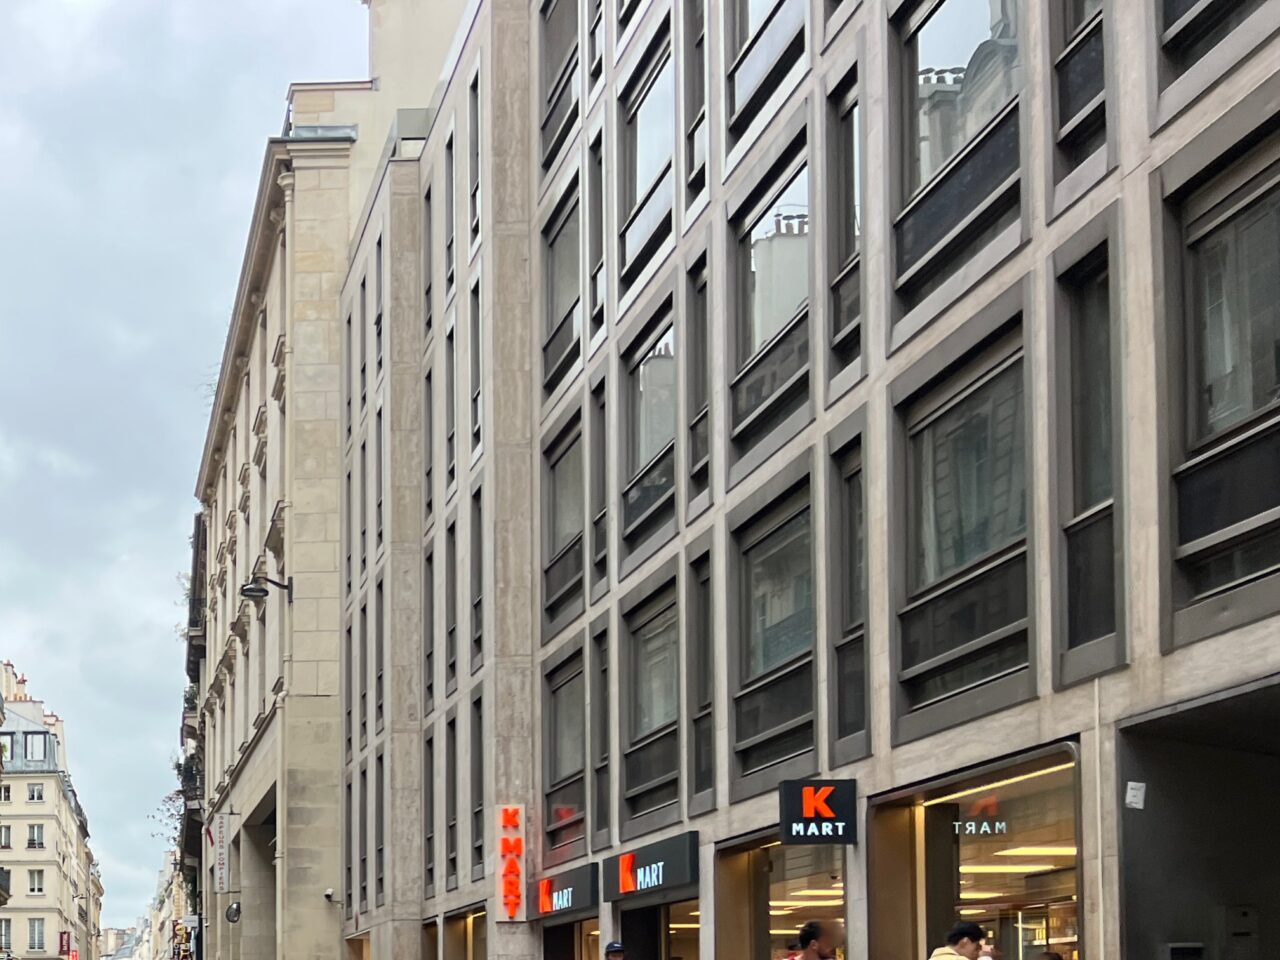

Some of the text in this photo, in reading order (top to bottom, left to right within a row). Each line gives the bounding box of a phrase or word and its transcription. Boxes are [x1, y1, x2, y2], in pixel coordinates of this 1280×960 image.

[802, 786, 836, 818] K
[792, 822, 845, 836] MART
[501, 808, 523, 919] K MART
[619, 853, 664, 894] K MART
[539, 879, 573, 913] K MART
